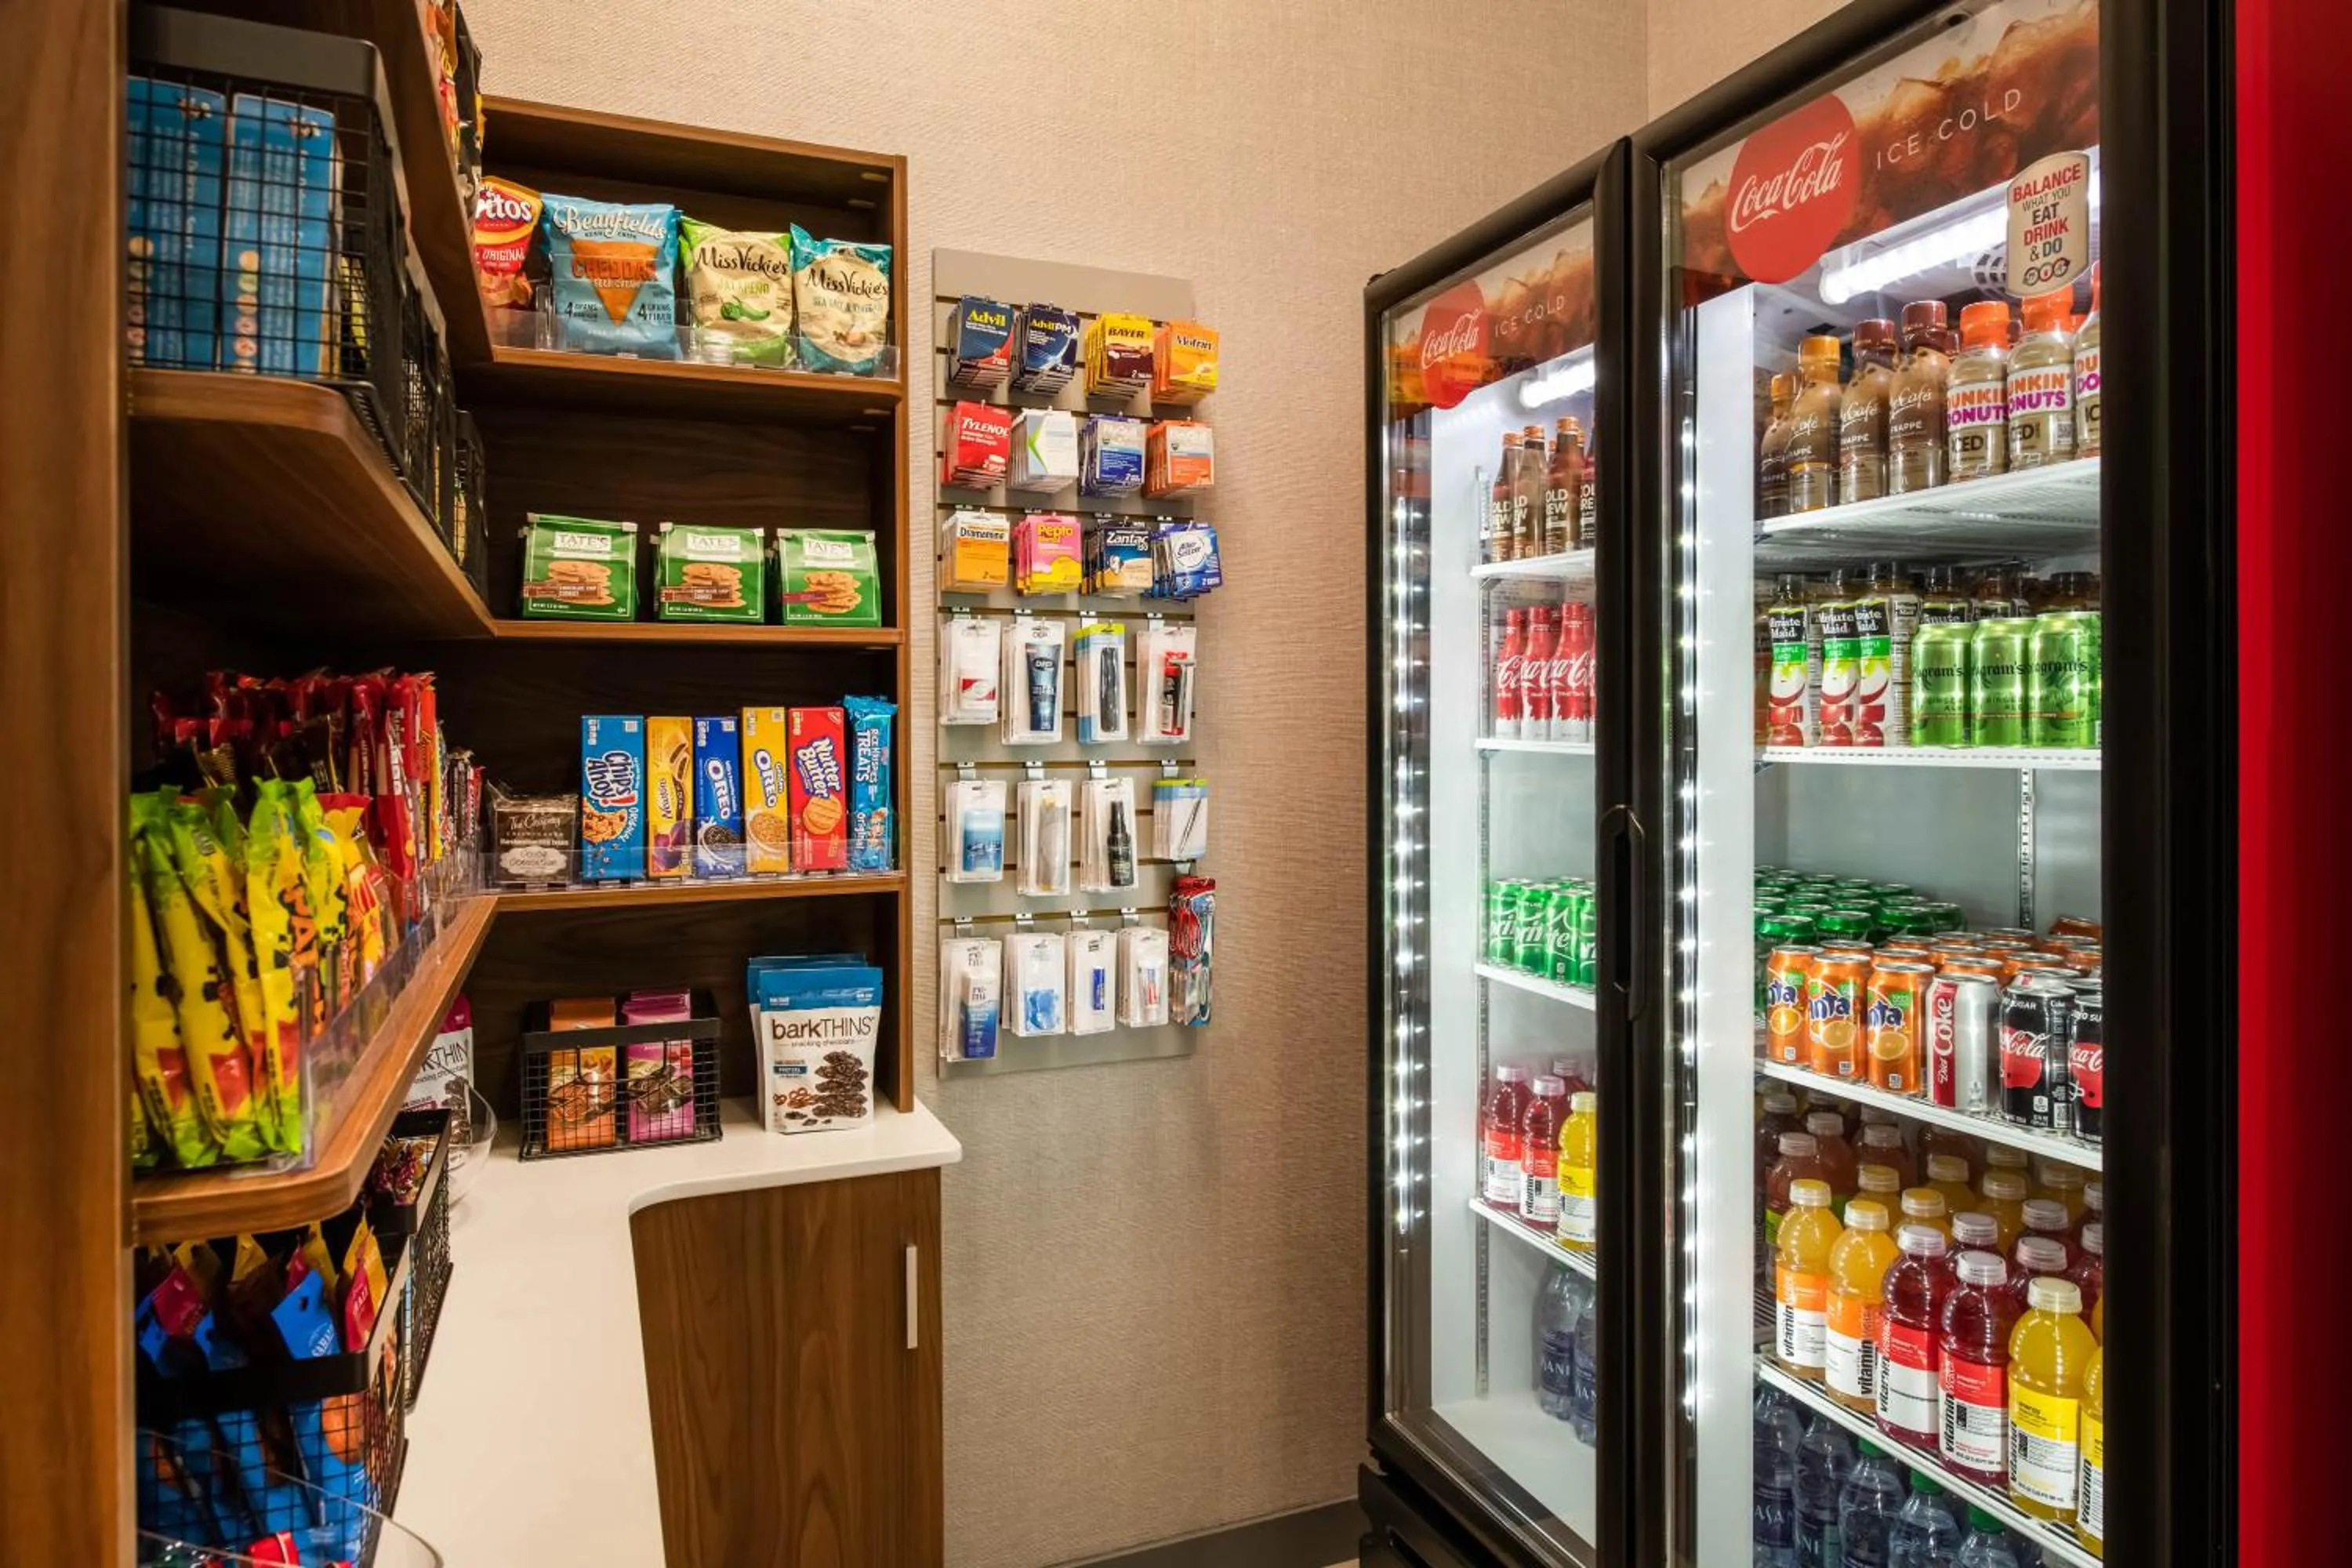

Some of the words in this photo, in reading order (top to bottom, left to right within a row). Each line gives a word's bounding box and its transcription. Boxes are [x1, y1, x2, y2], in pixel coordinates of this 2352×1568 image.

[1876, 132, 1919, 170] ICE
[1937, 88, 2022, 141] COLD
[1730, 128, 1851, 234] Coca-Cola
[2013, 163, 2081, 203] BALANCE
[475, 191, 533, 222] ritos
[2023, 194, 2047, 212] WHAT
[2052, 185, 2071, 201] YOU
[2032, 201, 2060, 225] EAT
[554, 204, 666, 238] Beanfields
[2024, 217, 2070, 246] DRINK
[2030, 245, 2039, 263] &
[2042, 237, 2063, 258] DO
[968, 309, 1007, 327] Advil
[1031, 319, 1054, 331] Advil
[1054, 322, 1072, 333] PM
[1495, 317, 1517, 337] ICE
[1525, 296, 1566, 325] COLD
[1108, 326, 1145, 339] BAYER
[2009, 372, 2071, 391] NKIN'
[2009, 391, 2066, 414] ONUTS
[962, 417, 1011, 437] TYLENOL
[1493, 500, 1513, 514] OLD
[1544, 488, 1569, 502] OLD
[557, 534, 610, 546] TATE'S
[690, 535, 739, 547] TATE'S
[1037, 523, 1074, 542] Pepto
[1106, 532, 1149, 547] Zantac
[812, 737, 841, 791] Nutter
[856, 730, 871, 782] TREATS
[755, 750, 778, 808] OREO
[797, 746, 829, 798] Butter
[706, 758, 731, 819] OREO
[1769, 979, 1798, 1007] nta
[1809, 990, 1852, 1021] nta
[772, 1015, 872, 1040] barkTHINS
[1869, 1000, 1904, 1029] nta
[1934, 996, 1954, 1057] Coke
[1784, 1305, 1795, 1357] vitamin
[1858, 1339, 1874, 1396] vitamin
[1944, 1393, 1955, 1453] vitamin
[2082, 1458, 2092, 1523] vitamin
